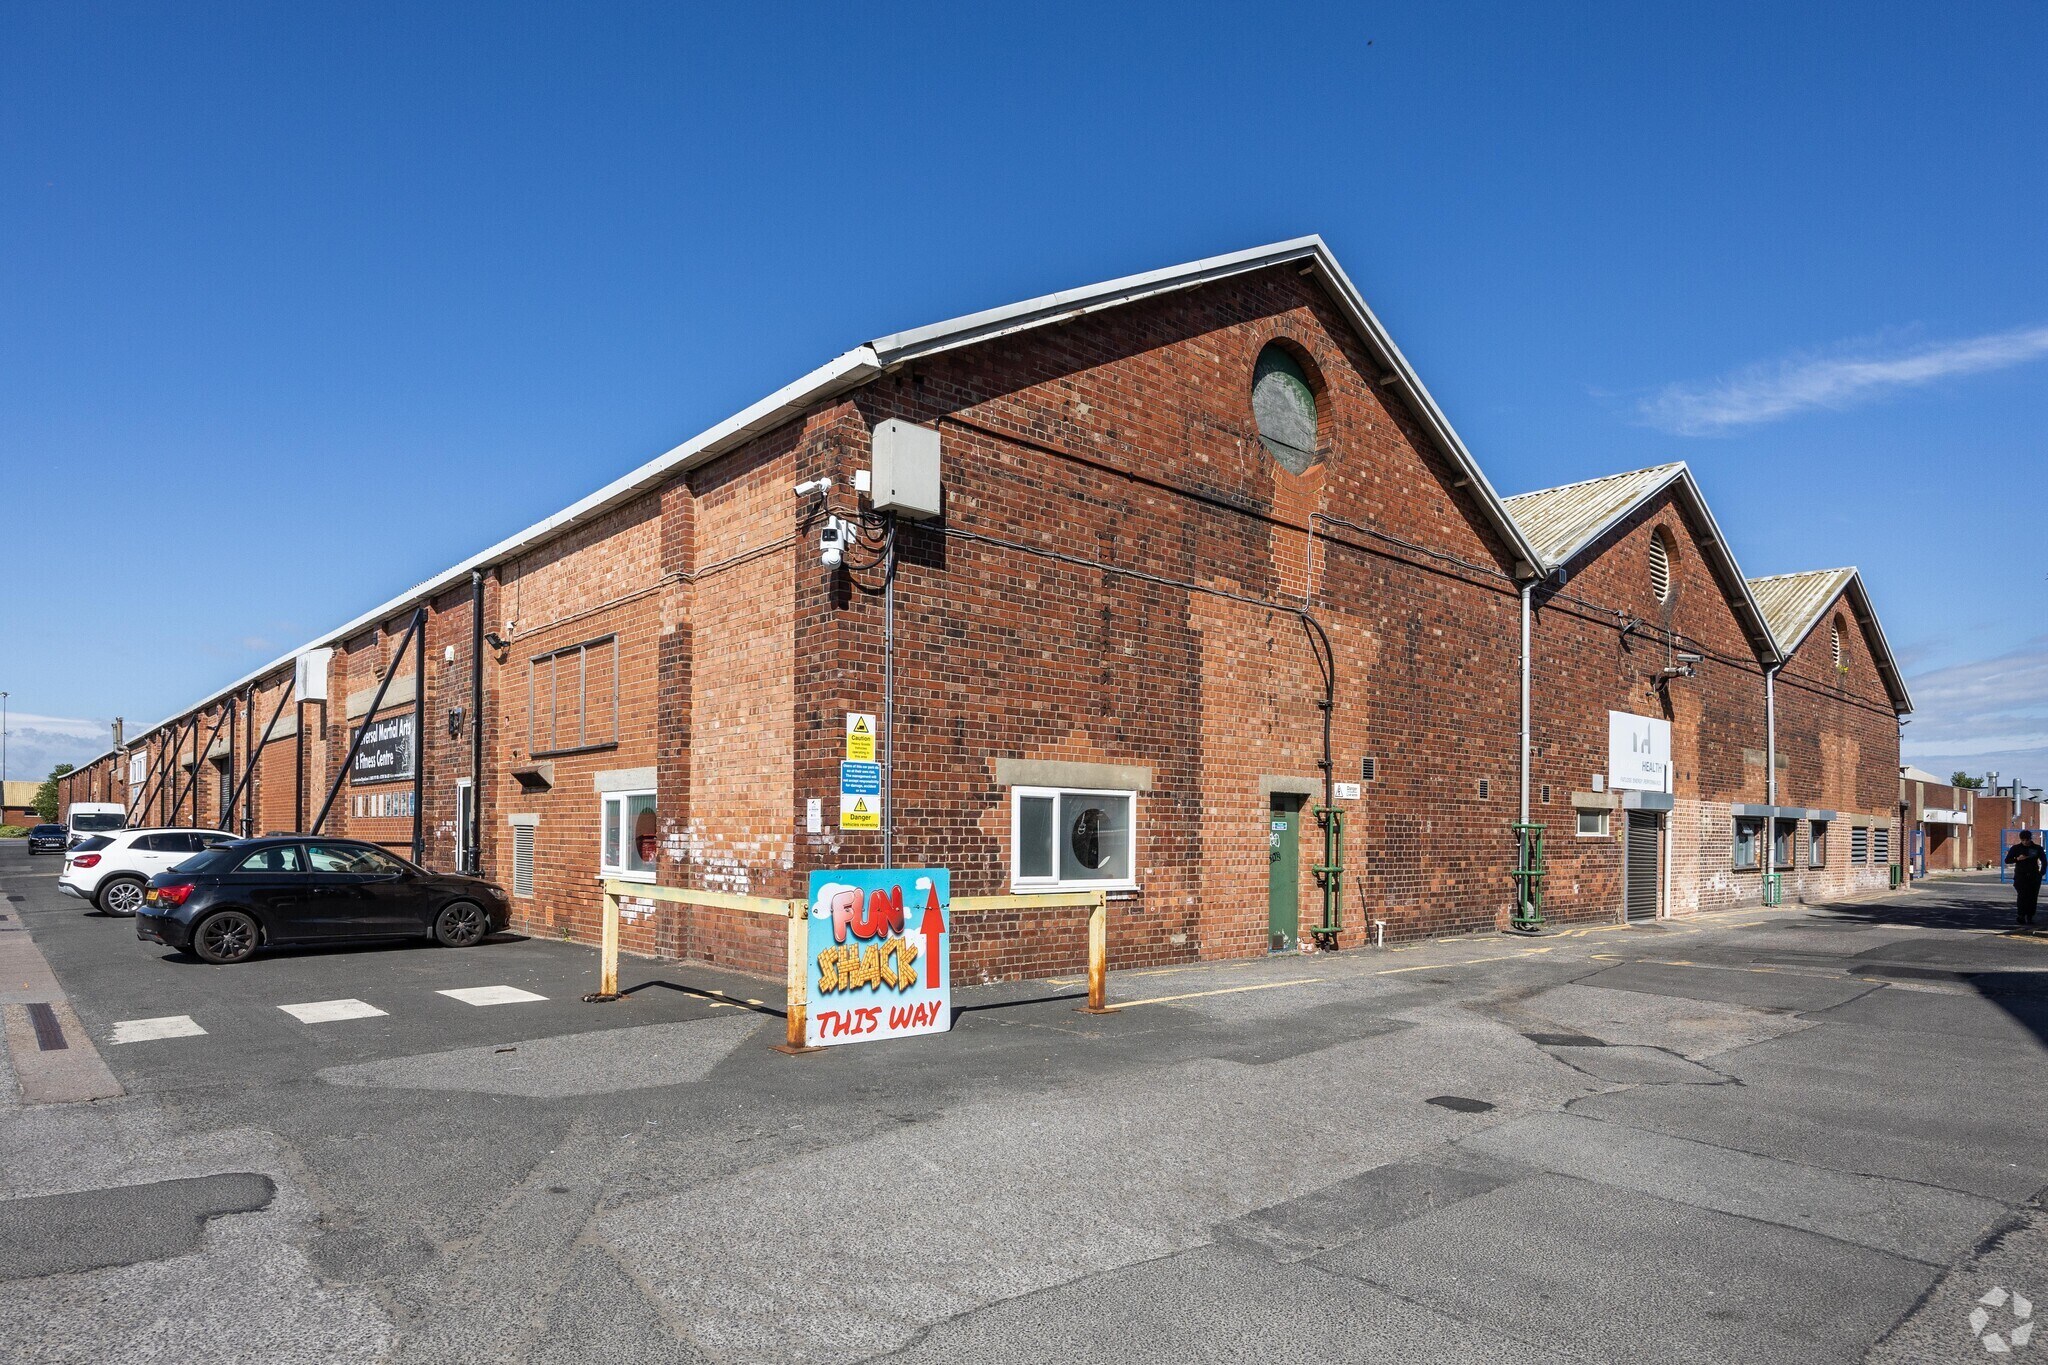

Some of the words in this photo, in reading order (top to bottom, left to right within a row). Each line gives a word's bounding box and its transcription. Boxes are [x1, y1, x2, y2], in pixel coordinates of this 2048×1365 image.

[378, 718, 398, 742] Martial
[399, 718, 411, 737] Arts
[355, 755, 360, 770] &
[360, 752, 376, 770] Fitness
[376, 749, 394, 768] Centre
[1642, 761, 1662, 773] HEALTH
[831, 884, 905, 942] FUN
[817, 936, 918, 994] SHACK
[816, 1006, 882, 1038] THIS
[889, 1000, 942, 1030] WAY
